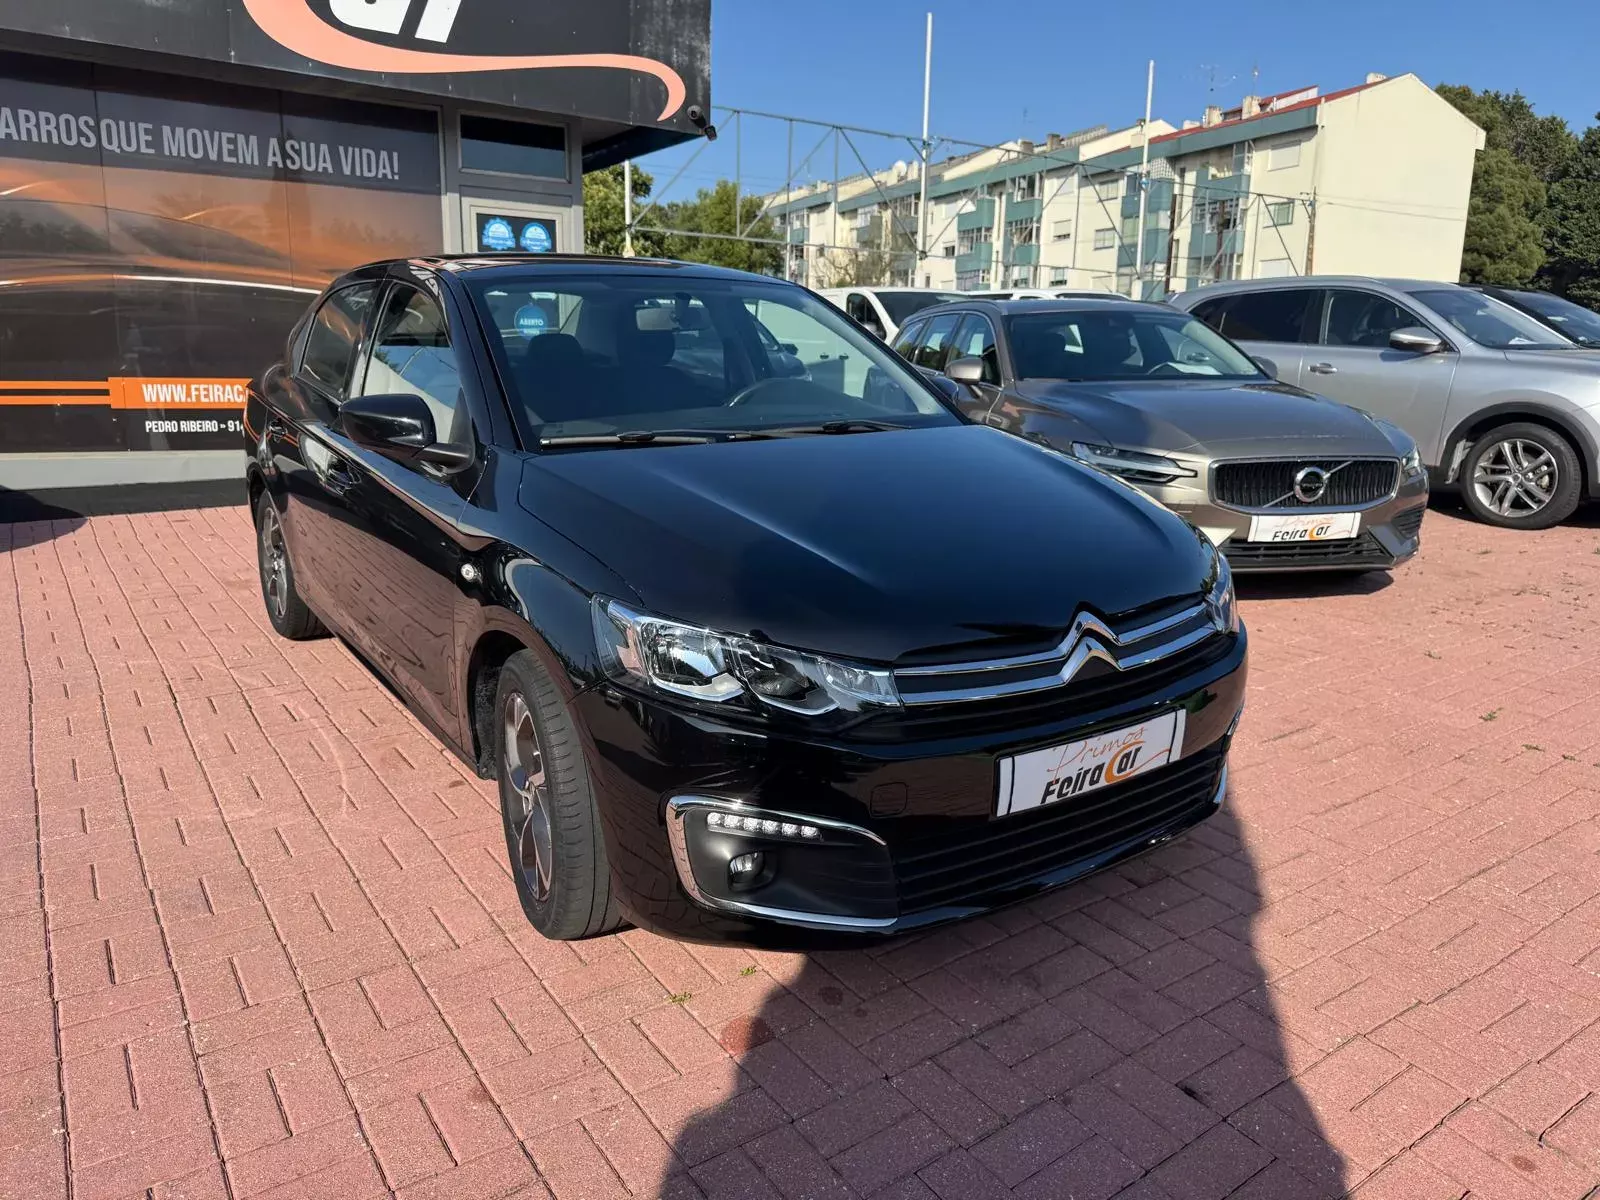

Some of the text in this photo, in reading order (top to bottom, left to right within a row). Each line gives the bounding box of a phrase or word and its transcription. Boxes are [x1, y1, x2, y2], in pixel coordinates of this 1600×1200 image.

[100, 118, 155, 154] QUE
[162, 125, 259, 166] MOVEM
[267, 137, 284, 169] A
[285, 139, 333, 174] SUA
[339, 145, 399, 180] VIDA!
[519, 318, 544, 326] ABERTO
[142, 383, 246, 403] WWW.FEIRAC
[145, 420, 178, 433] PEDRO
[180, 420, 218, 433] RIBEIRO
[1047, 725, 1148, 785] Primos
